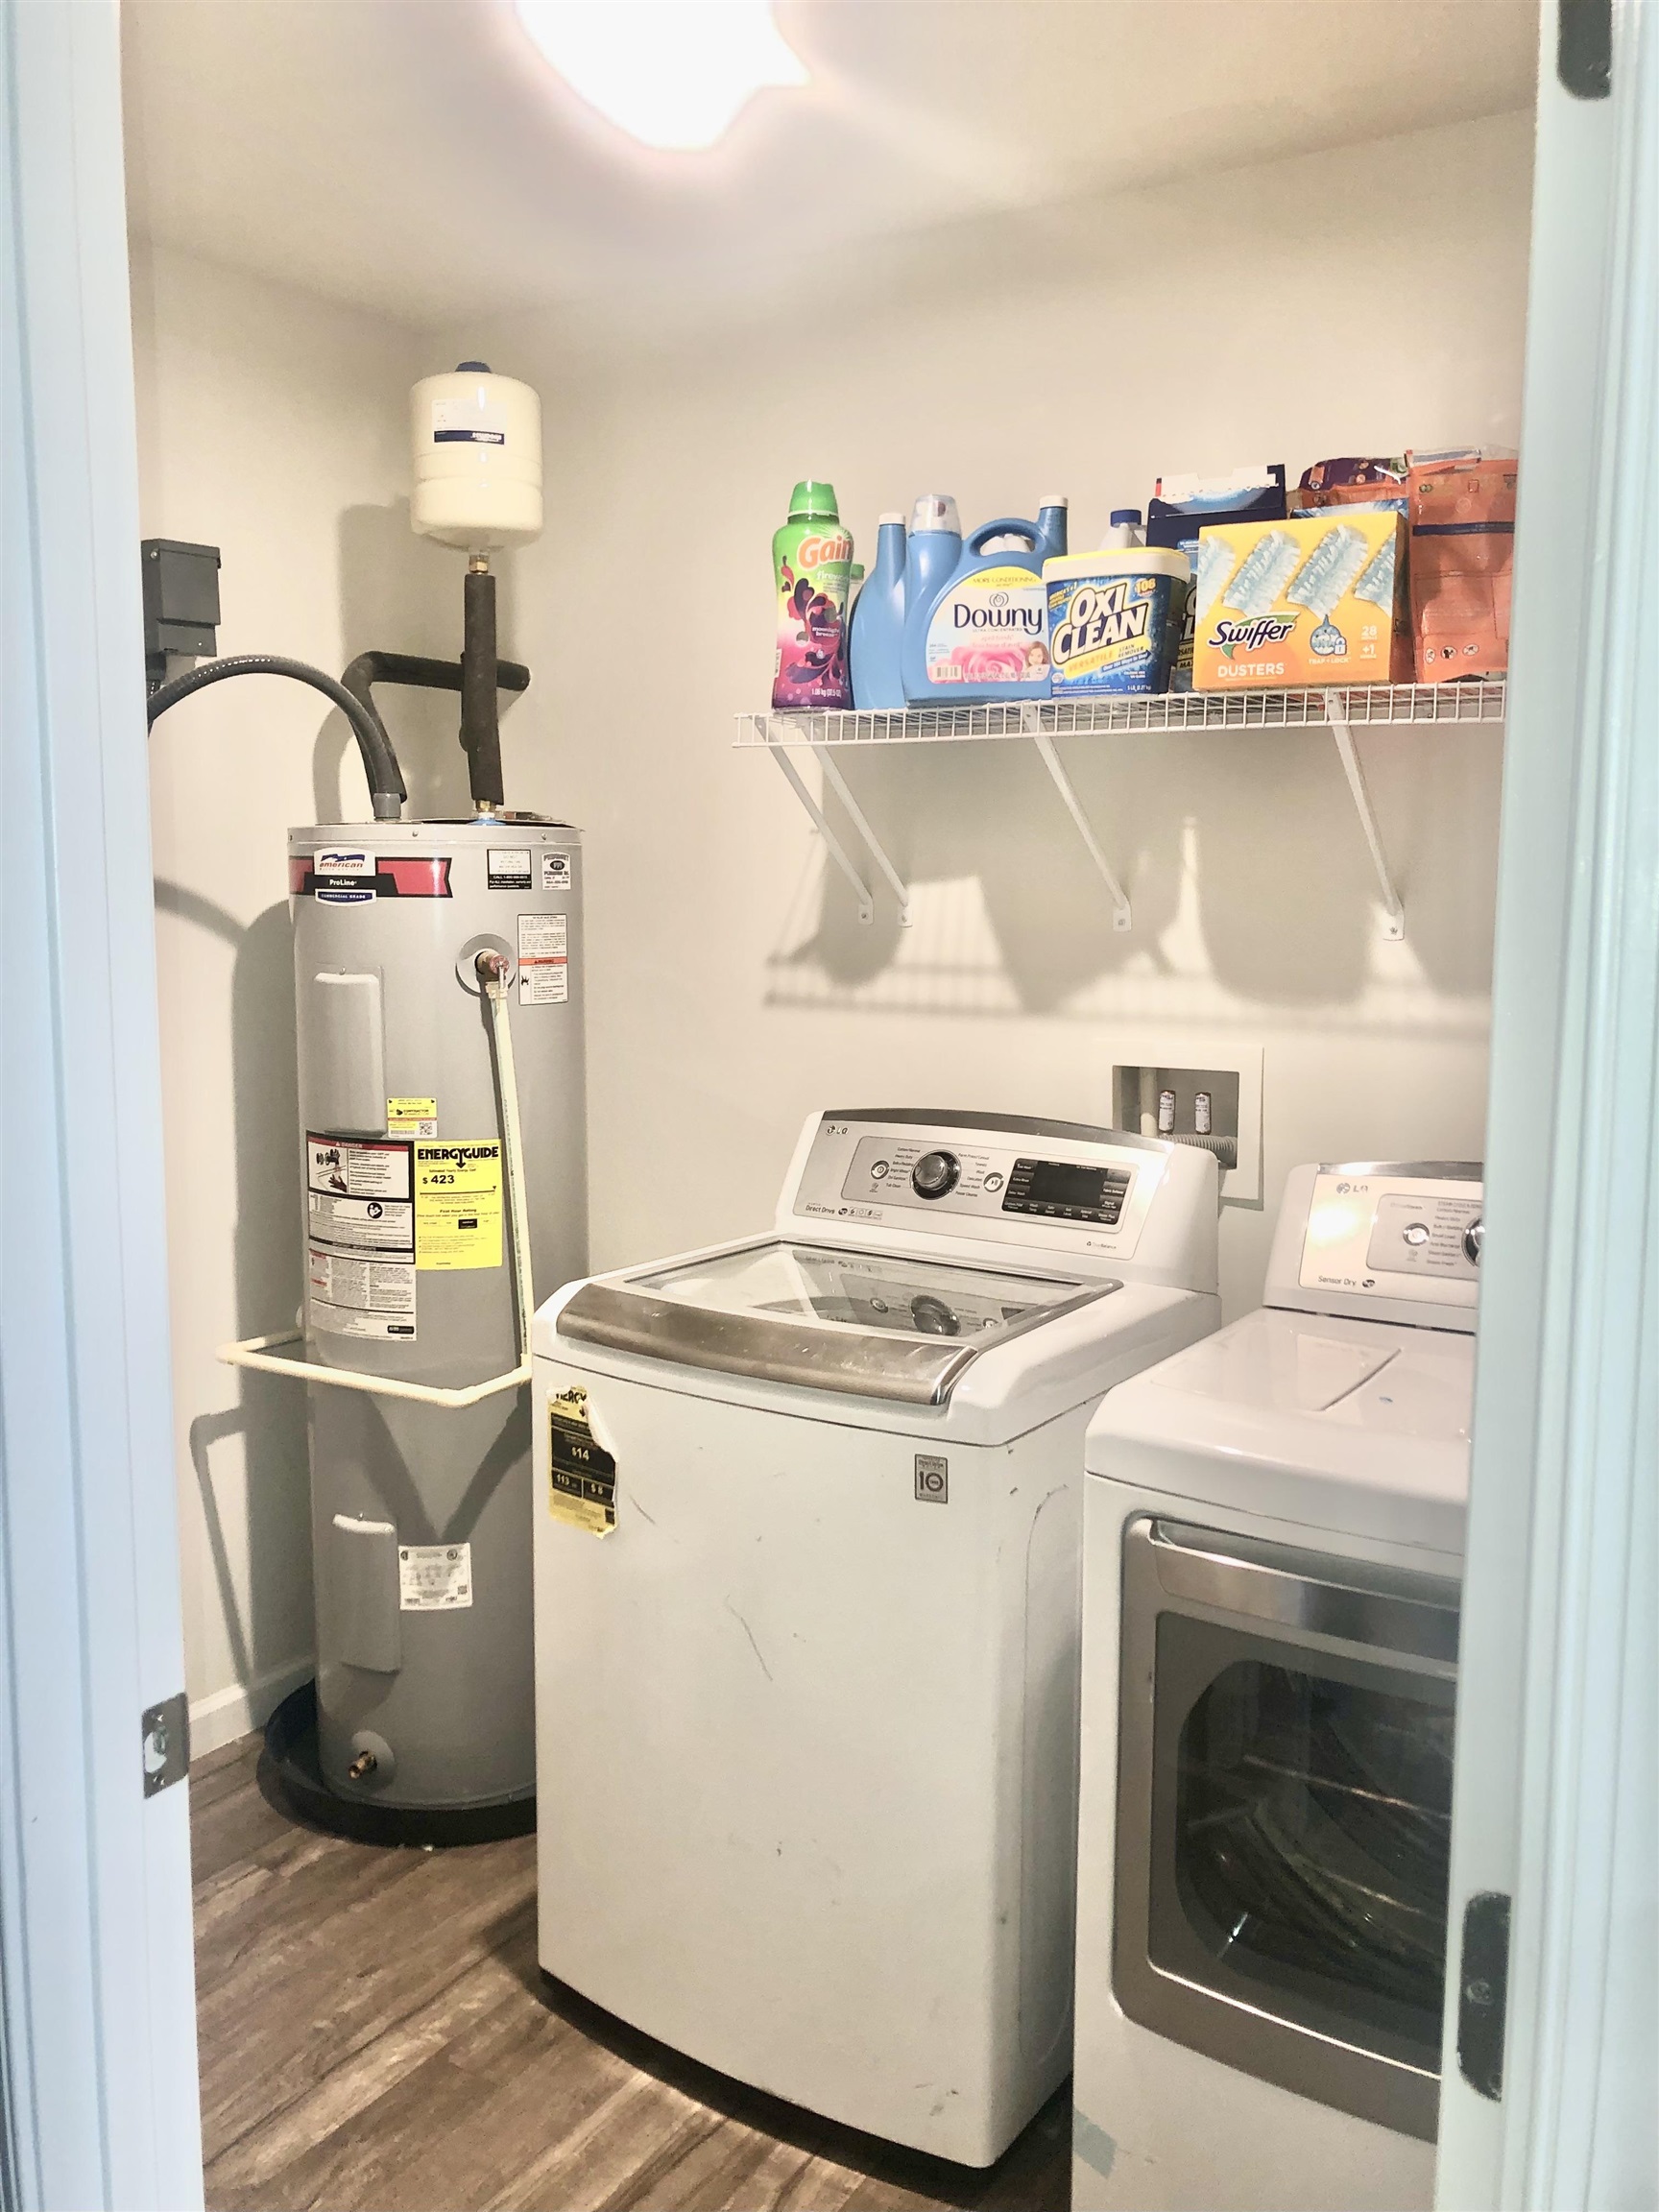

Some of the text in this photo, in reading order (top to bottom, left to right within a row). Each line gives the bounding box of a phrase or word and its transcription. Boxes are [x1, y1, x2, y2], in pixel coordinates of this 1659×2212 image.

[799, 536, 852, 570] Gain
[1070, 583, 1127, 628] OXI
[953, 604, 1043, 636] Downy
[1052, 603, 1148, 664] CLEAN
[1209, 619, 1292, 650] Swiffer
[1361, 625, 1377, 637] 28
[1362, 644, 1375, 655] +1
[1069, 650, 1114, 671] VERSATILE
[1217, 662, 1285, 678] DUSTERS
[418, 1146, 498, 1162] ENERGYGUIDE
[431, 1174, 454, 1184] 423
[1318, 1276, 1357, 1286] Sensor Dry
[571, 1447, 589, 1461] $14
[919, 1471, 944, 1492] 10
